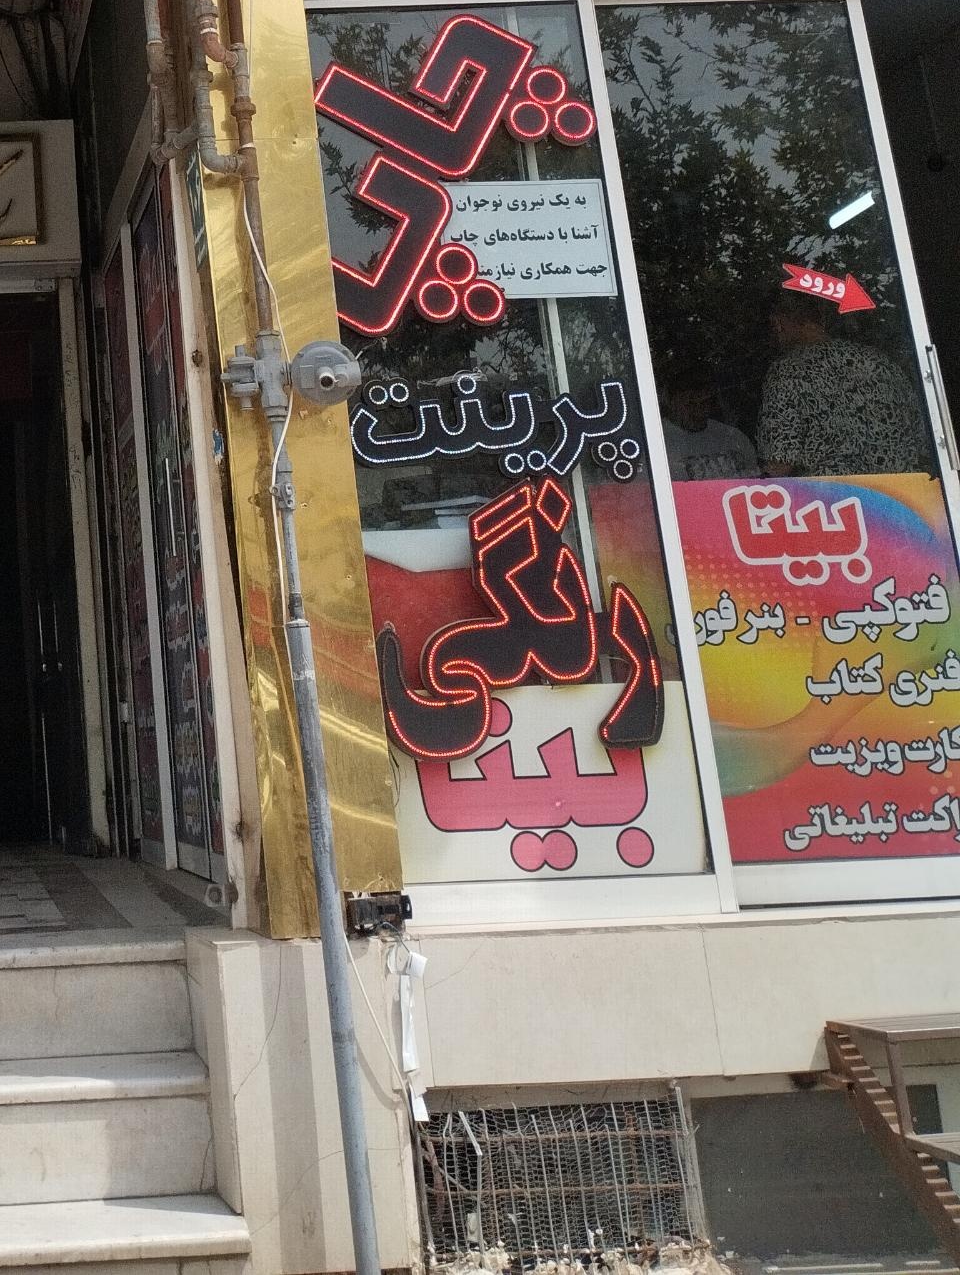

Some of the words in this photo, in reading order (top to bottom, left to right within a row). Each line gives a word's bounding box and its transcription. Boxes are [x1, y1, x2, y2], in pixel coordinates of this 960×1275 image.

[455, 195, 503, 213] نوجوان
[507, 194, 545, 212] نیروی
[548, 193, 570, 210] یک
[574, 194, 587, 209] به
[558, 227, 568, 243] با
[571, 224, 599, 240] آشنا
[520, 262, 572, 280] همکاری
[575, 263, 608, 278] جهت
[800, 273, 846, 299] ورود
[350, 374, 643, 481] پرینت
[722, 484, 872, 586] بیتا
[376, 476, 663, 761] رنگی
[822, 574, 951, 644] فتوکپی
[736, 602, 786, 644] بنر
[806, 652, 884, 705] کتاب
[809, 737, 905, 777] ویزیت
[784, 801, 898, 852] تبلیغاتی
